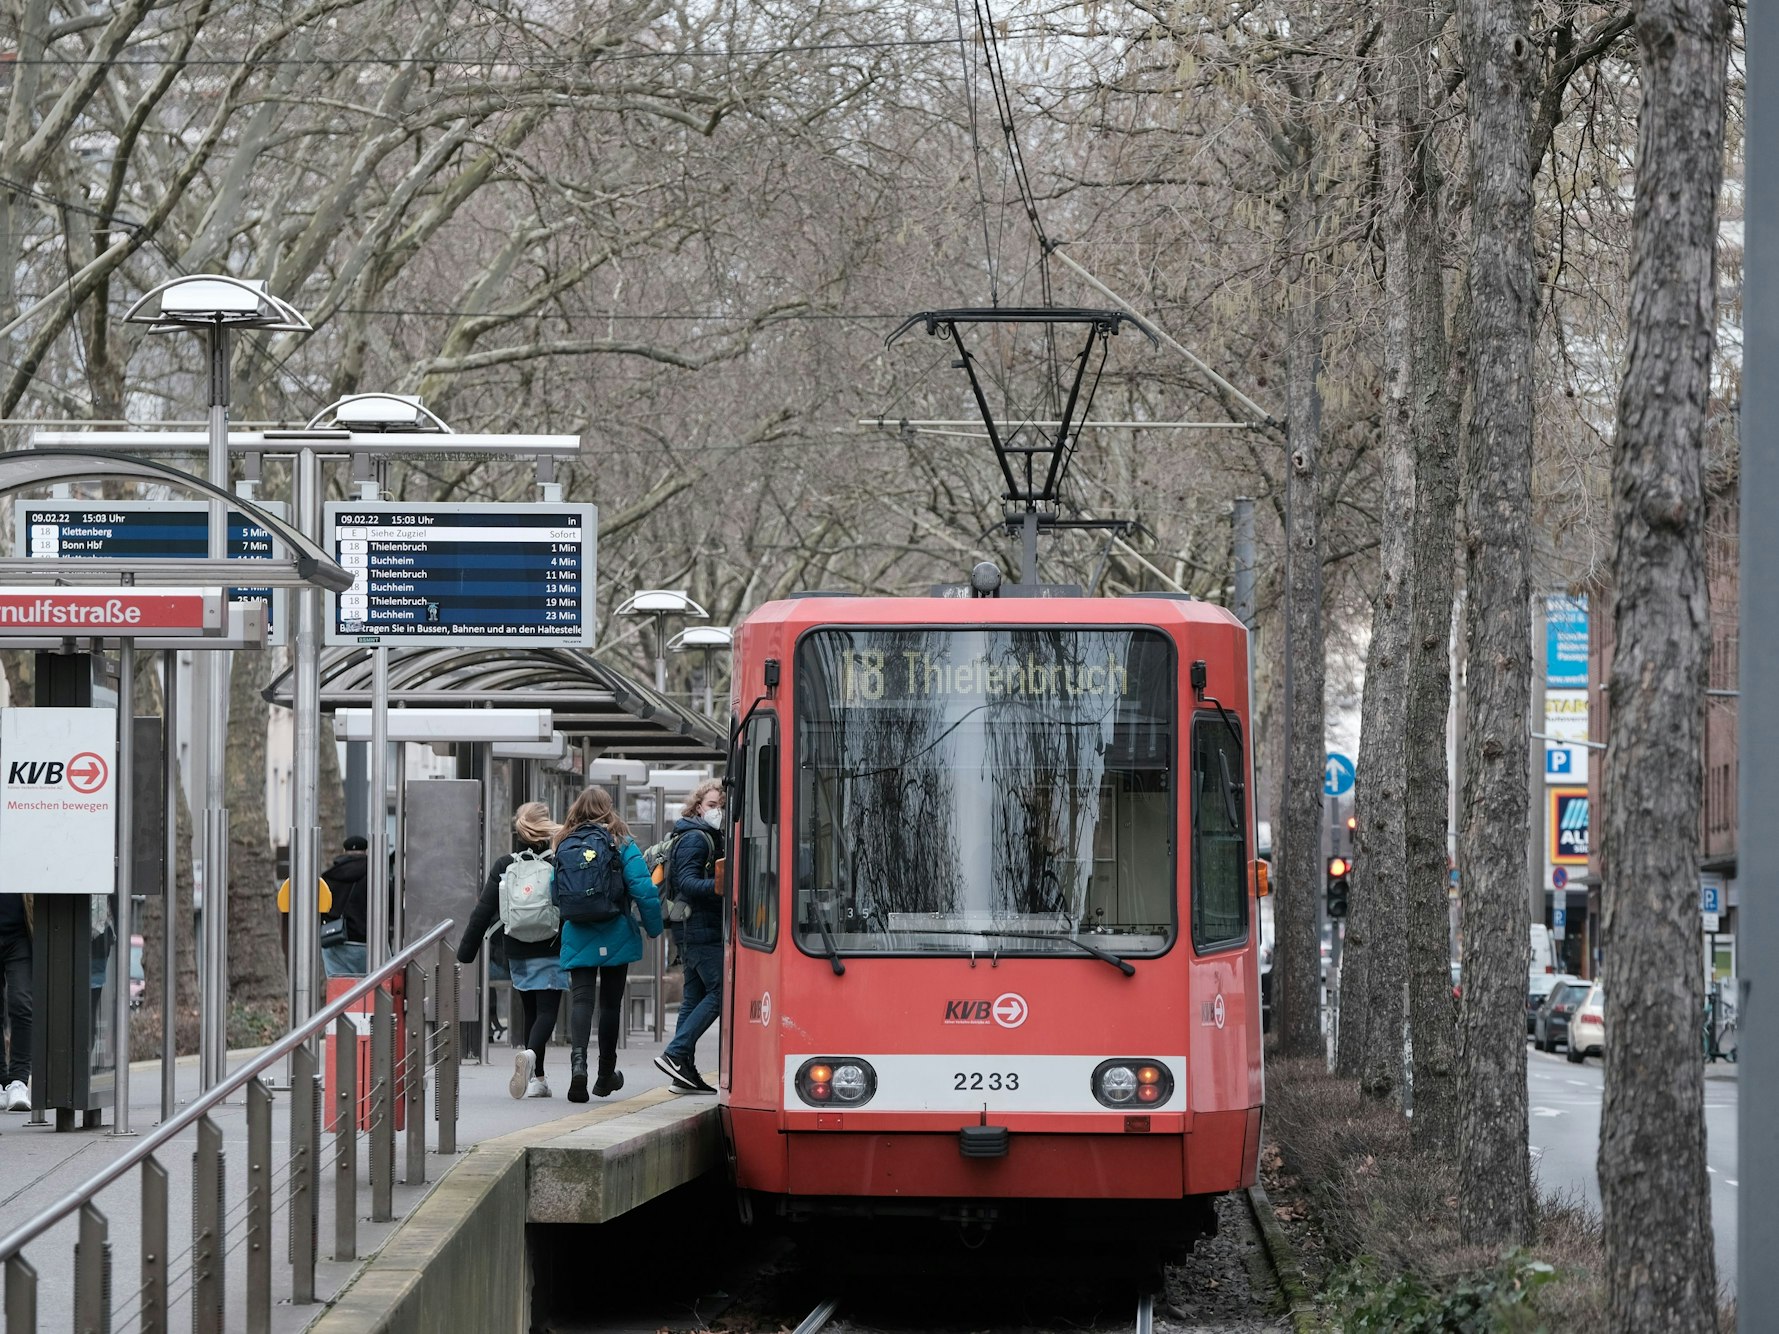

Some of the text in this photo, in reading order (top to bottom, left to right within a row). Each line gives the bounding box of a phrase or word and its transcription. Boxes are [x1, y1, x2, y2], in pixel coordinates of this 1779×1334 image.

[32, 513, 126, 523] 09.02.22 15:03 Uhr
[341, 515, 577, 526] 09.02.22 15:03 Uhr in
[40, 527, 268, 539] 18 Klettenberg 5 Min
[370, 529, 395, 538] Siehe
[396, 529, 427, 540] Zugziel
[549, 530, 577, 539] Sofort
[40, 540, 268, 551] 18 Bonn Hbf 7 Min
[349, 541, 577, 553] 18 Thielenbruch 1 Min
[349, 555, 577, 566] 18 Buchheim 4 Min
[370, 568, 428, 579] Thielenbruch
[545, 570, 557, 580] 11
[558, 570, 577, 580] Min
[349, 582, 577, 593] 18 Buchheim 13 Min
[349, 595, 577, 607] 18 Thielenbruch 19 Min
[349, 609, 577, 621] 18 Buchheim 23 Min
[362, 624, 391, 635] tragen
[391, 623, 405, 633] Sie
[406, 623, 416, 633] in
[417, 624, 451, 635] Bussen,
[452, 624, 485, 634] Bahnen
[486, 624, 505, 634] und
[505, 625, 517, 634] an
[518, 624, 536, 634] den
[842, 648, 1129, 700] 18 Thielenbruch
[8, 761, 65, 785] KVB
[7, 800, 109, 813] Menschen bewegen
[945, 1000, 992, 1020] KVB
[953, 1072, 1020, 1091] 2233
